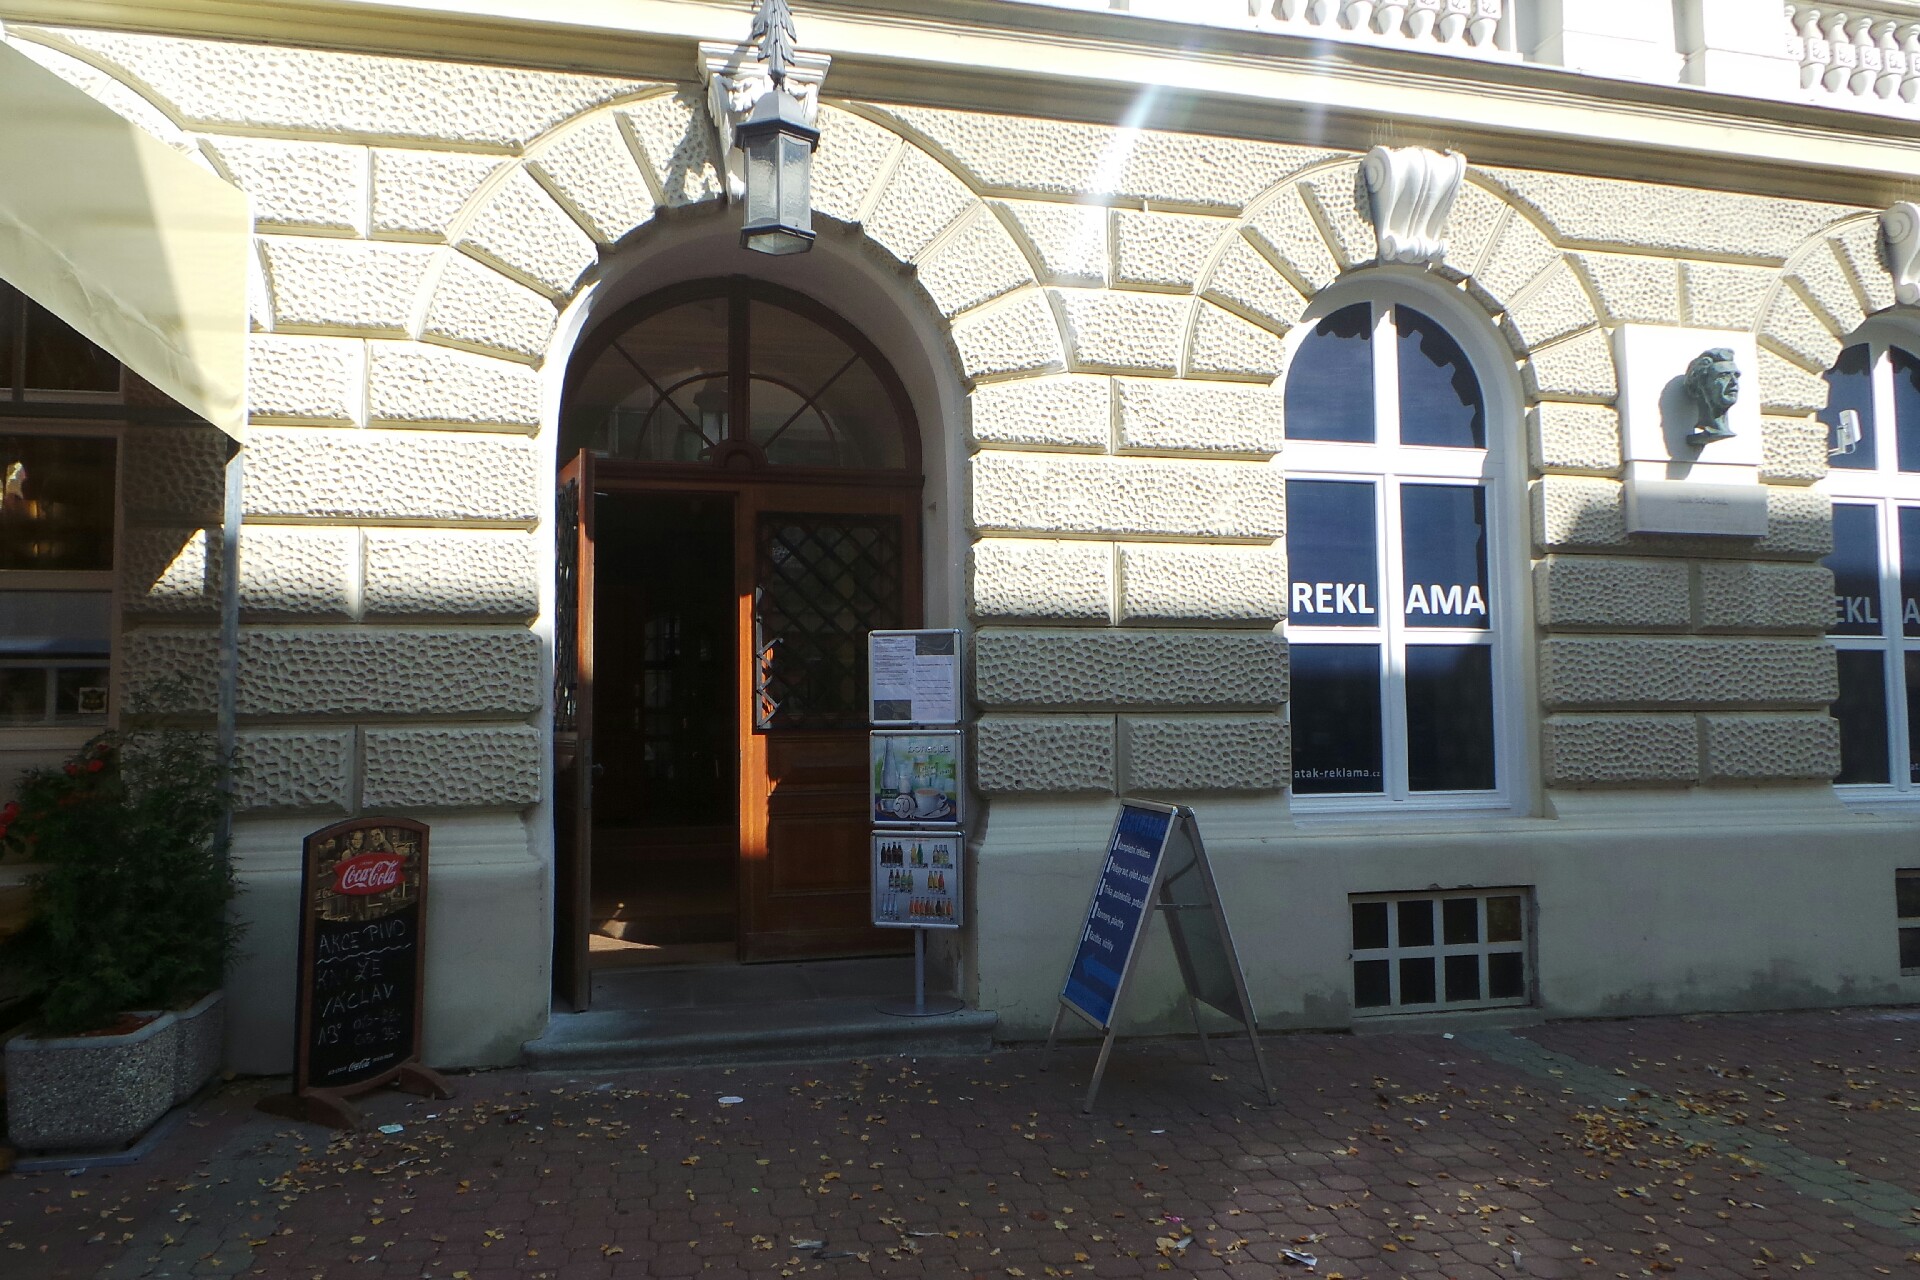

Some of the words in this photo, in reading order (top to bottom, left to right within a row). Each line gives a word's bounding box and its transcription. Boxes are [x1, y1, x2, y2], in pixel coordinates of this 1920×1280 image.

[1292, 582, 1375, 614] REKL
[1405, 584, 1487, 615] AMA
[1834, 596, 1878, 623] EKL
[1294, 767, 1381, 779] atak-reklama.cz
[342, 860, 399, 889] Coca-Cola
[319, 931, 360, 954] AKCE
[363, 919, 406, 942] PIVO
